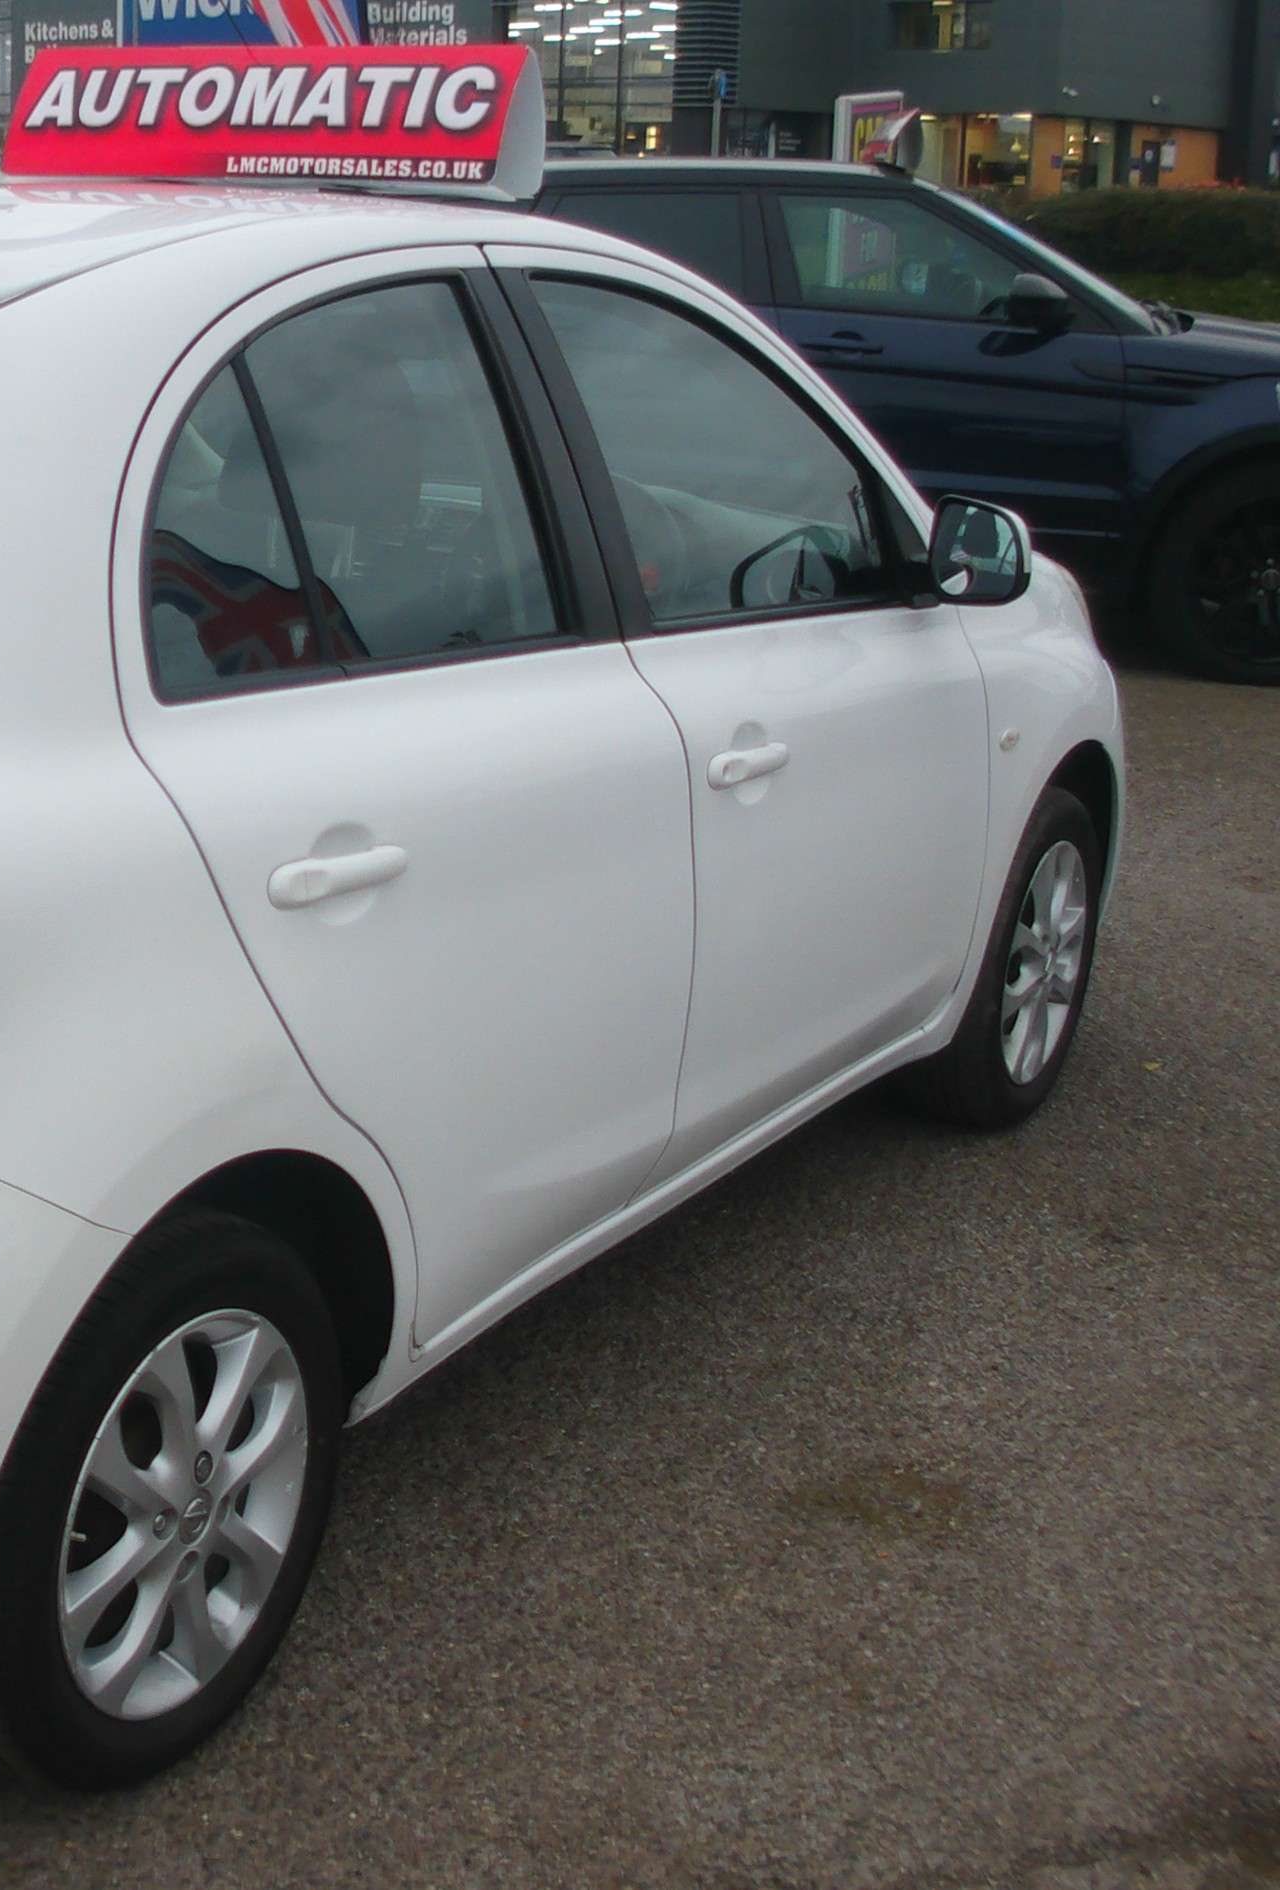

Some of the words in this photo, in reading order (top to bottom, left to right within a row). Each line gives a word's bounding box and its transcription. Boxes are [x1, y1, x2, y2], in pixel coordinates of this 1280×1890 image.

[368, 0, 454, 25] Building
[24, 21, 98, 41] Kitchens
[101, 18, 114, 38] &
[25, 66, 496, 129] AUTOMATIC
[226, 156, 482, 179] LMCMOTORSALES.CO.UK
